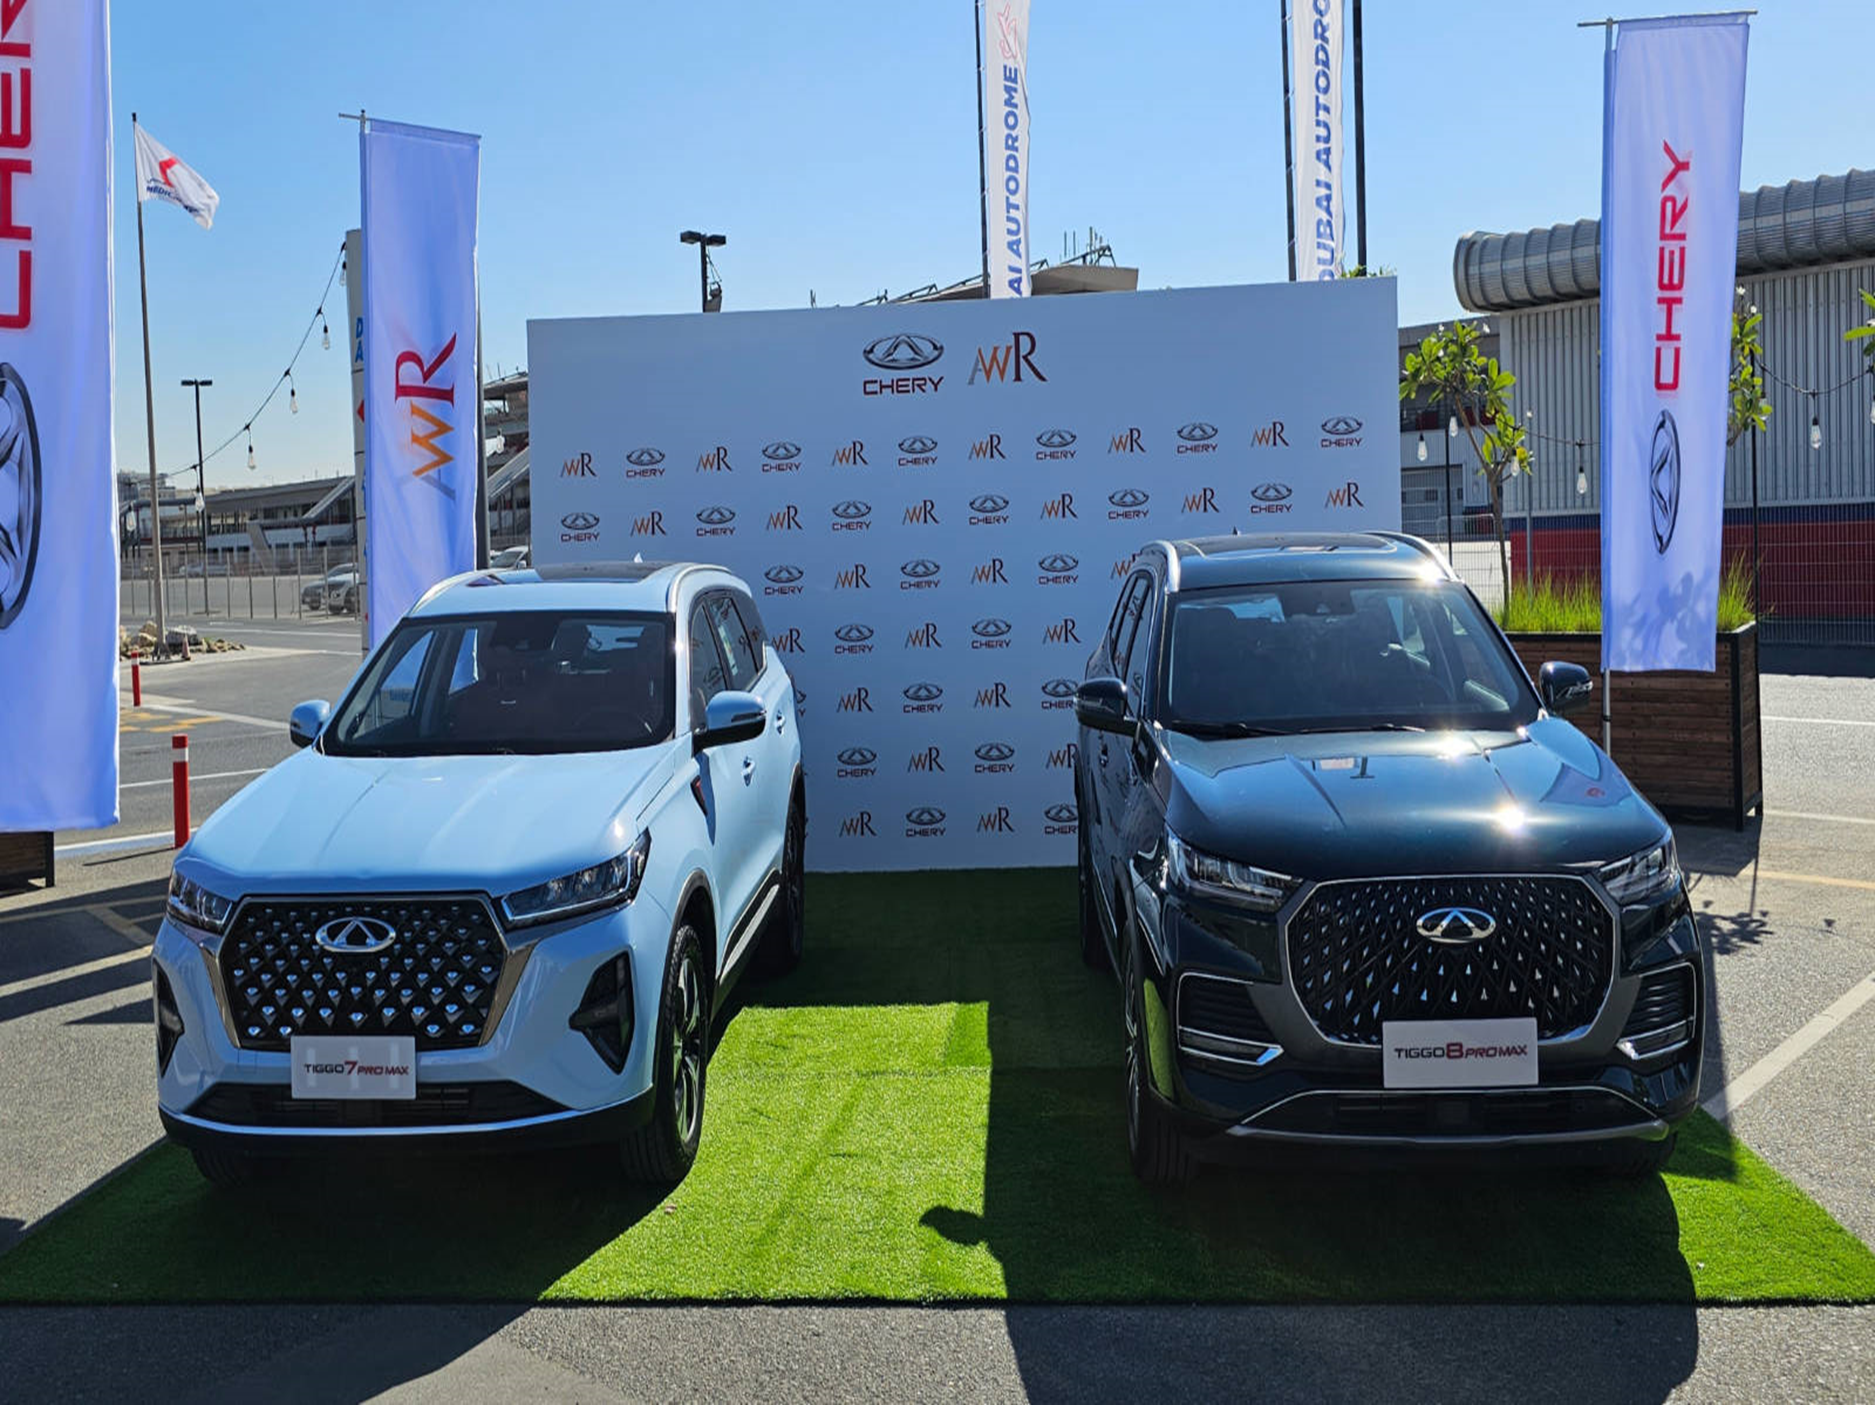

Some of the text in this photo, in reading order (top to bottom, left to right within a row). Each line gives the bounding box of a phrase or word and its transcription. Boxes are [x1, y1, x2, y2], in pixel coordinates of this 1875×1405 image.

[1003, 65, 1022, 260] AUTODROME
[1654, 139, 1690, 391] CHERY
[968, 332, 1048, 385] AWR
[863, 376, 944, 396] CHERY
[394, 332, 457, 500] AWR
[1108, 428, 1146, 453] AWR
[1251, 421, 1289, 447] AWR
[1321, 438, 1362, 448] CHERY
[832, 441, 868, 466] AWR
[969, 434, 1006, 460] AWR
[1036, 450, 1076, 460] CHERY
[1177, 444, 1217, 454] CHERY
[561, 453, 597, 477] AWR
[696, 446, 732, 472] AWR
[762, 463, 801, 472] CHERY
[898, 455, 937, 466] CHERY
[626, 468, 665, 478] CHERY
[1181, 487, 1219, 513] AWR
[1325, 482, 1364, 508] AWR
[902, 500, 939, 525] AWR
[1040, 493, 1078, 519] AWR
[1108, 510, 1149, 519] CHERY
[1250, 503, 1292, 514] CHERY
[630, 511, 666, 537] AWR
[766, 505, 802, 530] AWR
[832, 521, 871, 531] CHERY
[969, 515, 1009, 525] CHERY
[561, 532, 599, 542] CHERY
[696, 527, 735, 536] CHERY
[835, 564, 871, 589] AWR
[971, 558, 1008, 584] AWR
[1038, 575, 1078, 585] CHERY
[765, 586, 803, 595] CHERY
[900, 580, 940, 590] CHERY
[905, 623, 942, 648] AWR
[1043, 619, 1081, 644] AWR
[835, 645, 873, 654] CHERY
[971, 640, 1011, 649] CHERY
[837, 687, 873, 712] AWR
[974, 682, 1011, 708] AWR
[1041, 700, 1074, 710] CHER
[903, 704, 943, 713] CHERY
[908, 747, 945, 772] AWR
[975, 764, 1014, 773] CHERY
[837, 768, 876, 778] CHERY
[839, 811, 876, 837] AWR
[977, 807, 1014, 832] AWR
[906, 828, 945, 837] CHERY
[1044, 825, 1078, 835] CHER
[1394, 1047, 1445, 1059] TIGGO
[1465, 1046, 1498, 1059] PRO
[1499, 1044, 1527, 1057] MAX
[304, 1063, 344, 1074] TIGGO
[357, 1065, 384, 1075] PRO
[385, 1065, 409, 1075] MAX
